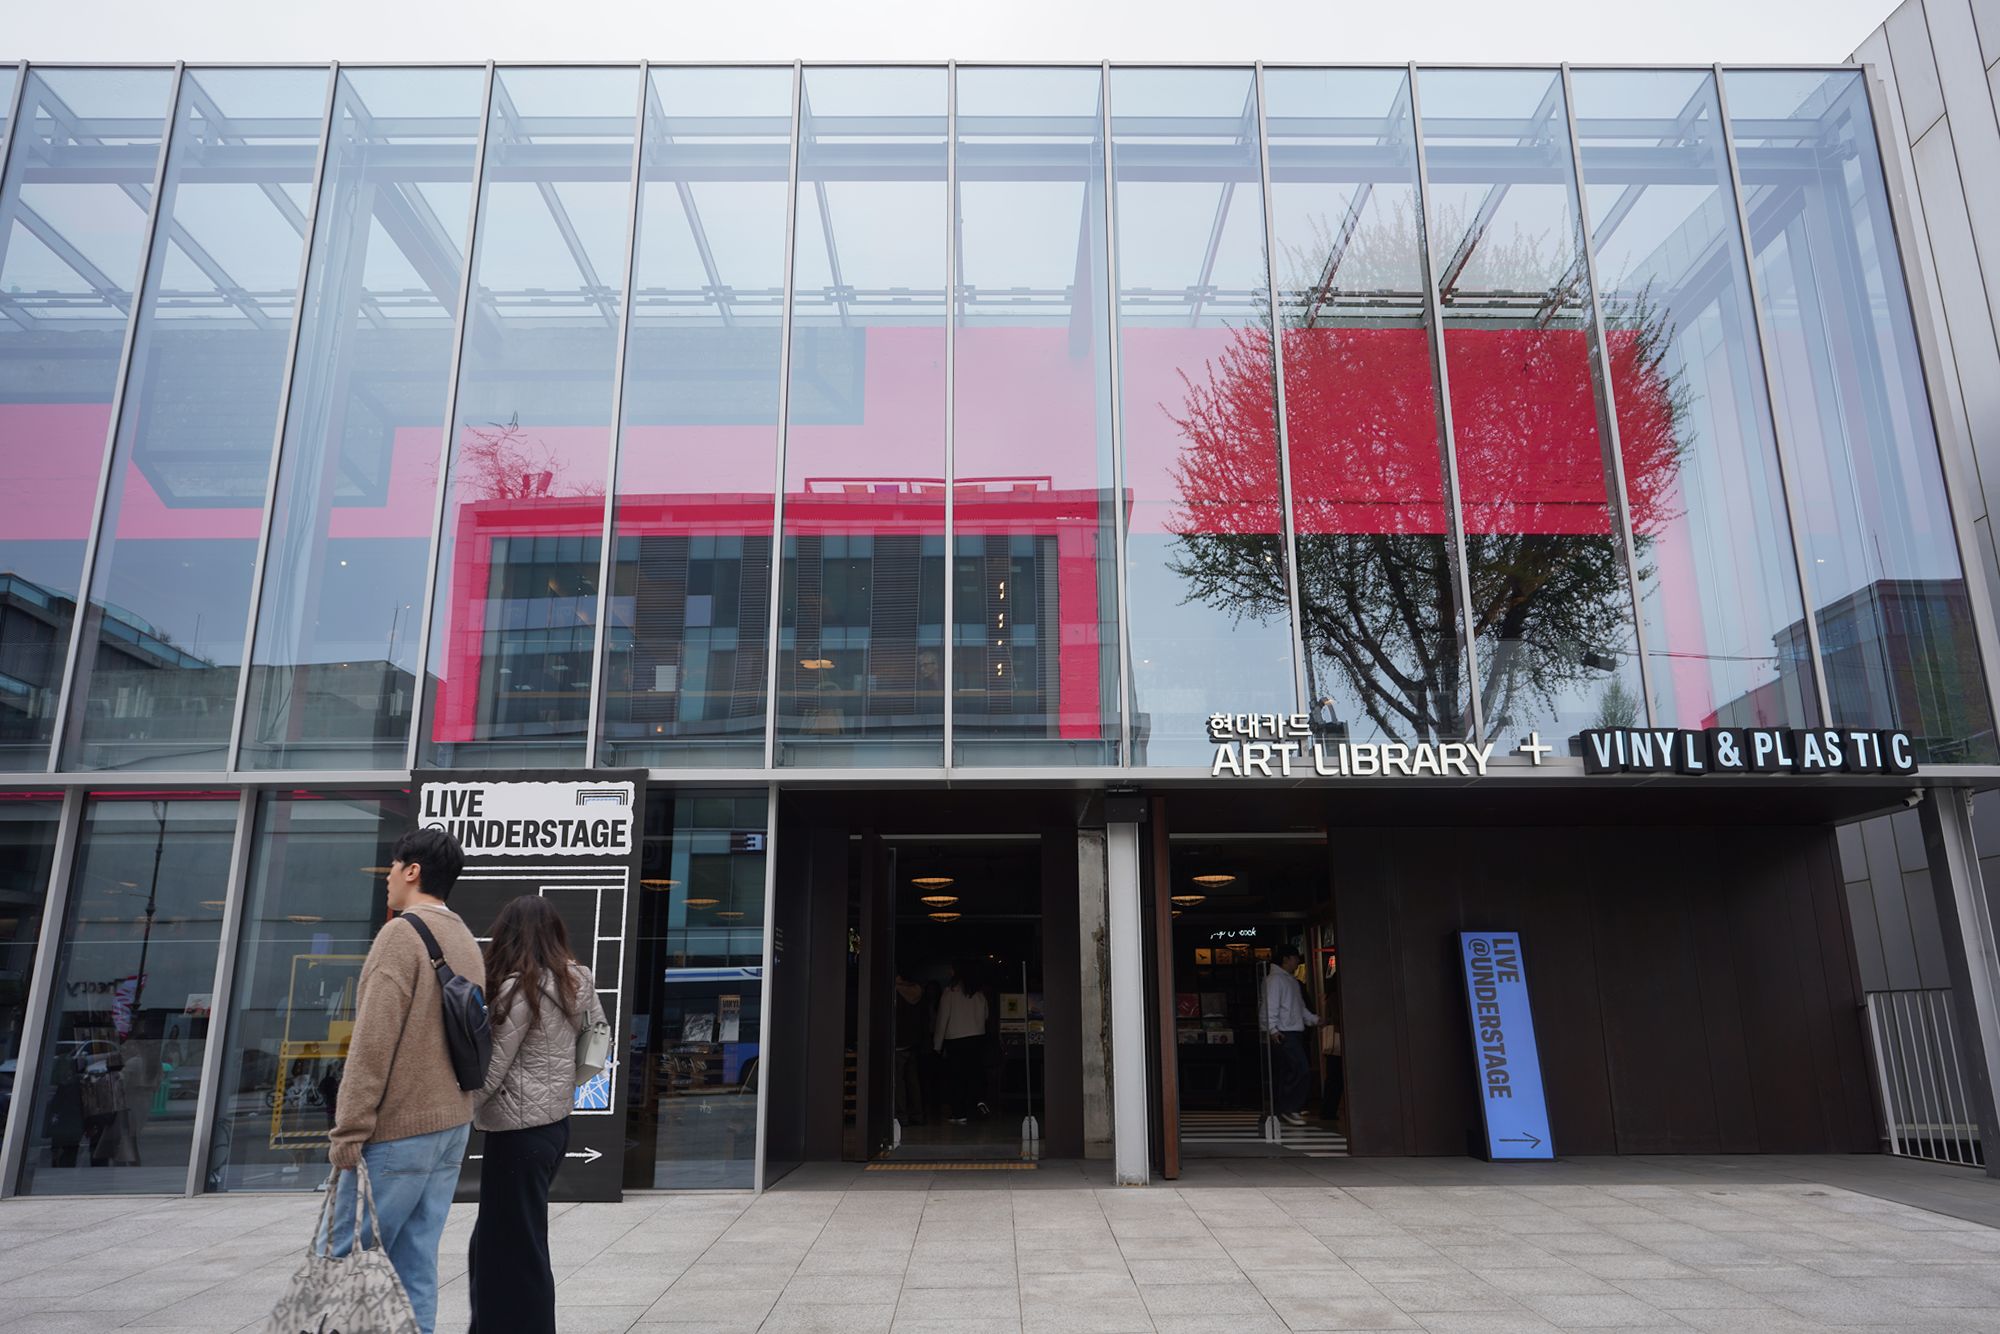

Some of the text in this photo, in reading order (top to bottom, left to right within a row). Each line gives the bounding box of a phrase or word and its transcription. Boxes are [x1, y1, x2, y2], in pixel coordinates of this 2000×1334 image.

[1209, 712, 1313, 738] 현대카드
[1212, 743, 1299, 776] ART
[1314, 743, 1494, 776] LIBRARY
[1591, 731, 1913, 769] VINYL & PLASTIC
[425, 789, 485, 817] LIVE
[1492, 938, 1521, 983] LIVE
[1468, 938, 1513, 1099] @UNDERSTAGE
